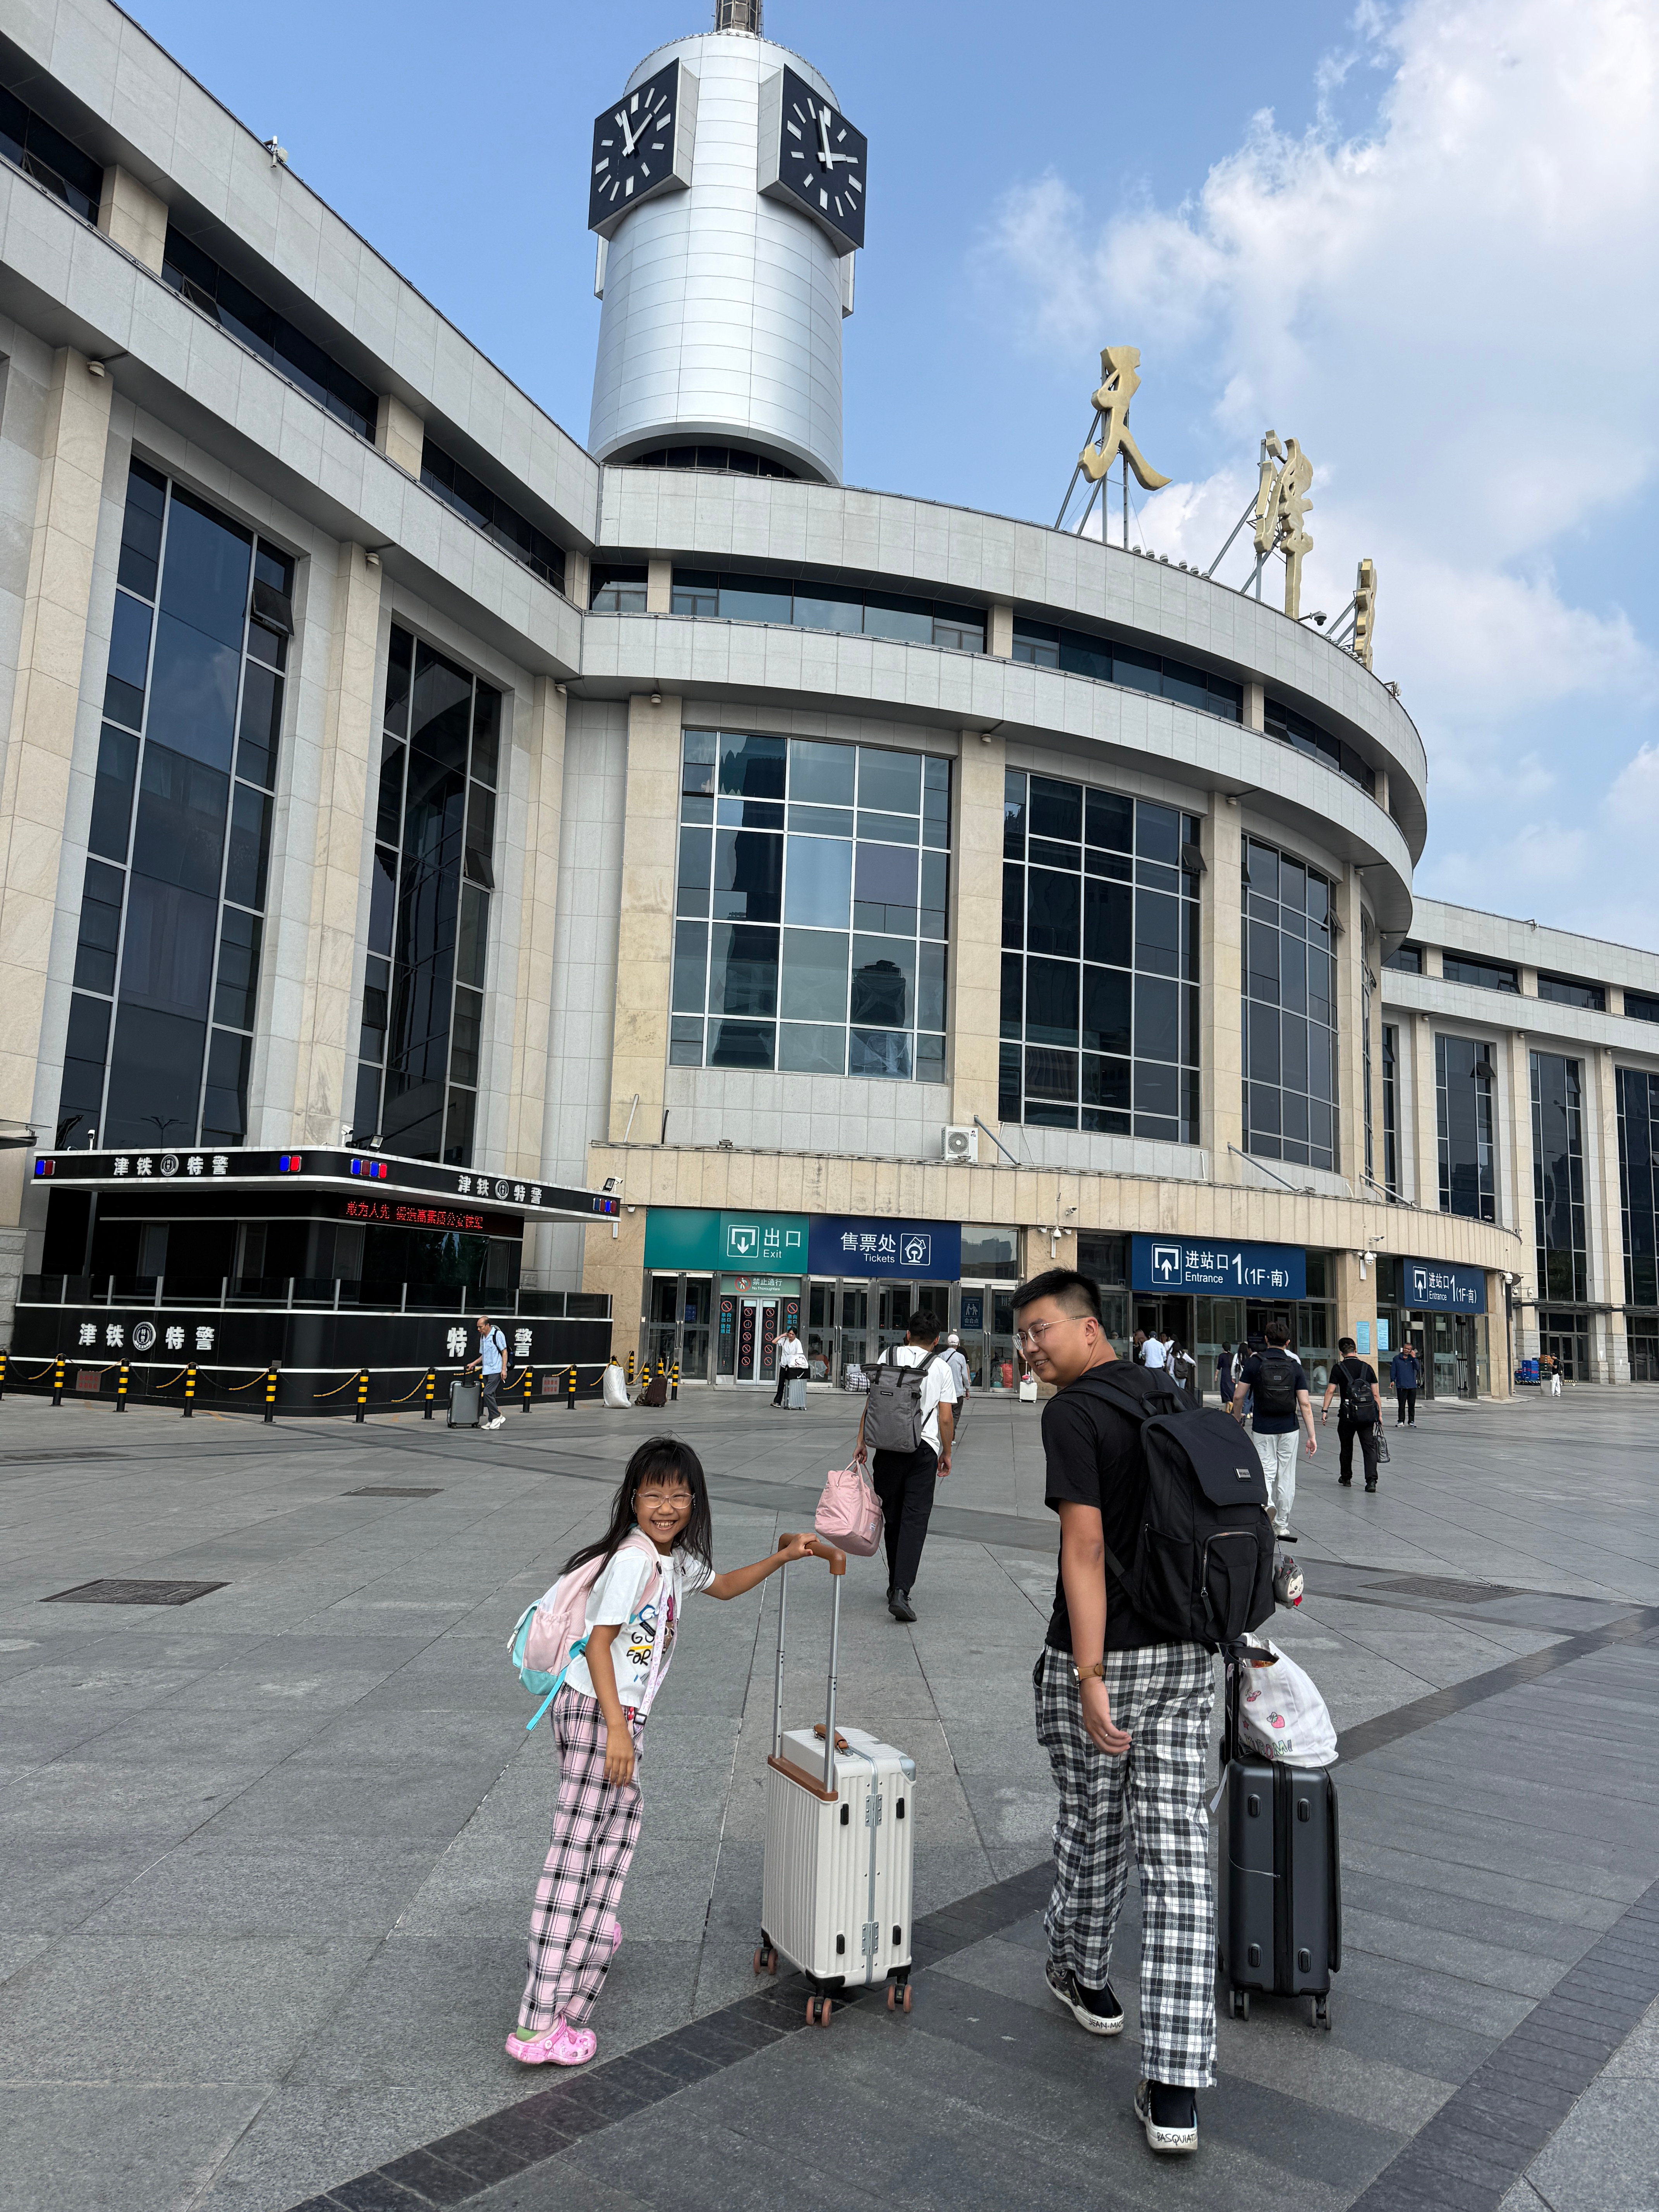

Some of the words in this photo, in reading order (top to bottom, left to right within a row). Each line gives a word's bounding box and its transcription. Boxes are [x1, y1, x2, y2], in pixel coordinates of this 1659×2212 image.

[113, 1157, 152, 1175] 津铁
[187, 1156, 228, 1175] 特警
[458, 1175, 489, 1197] 津铁
[514, 1185, 542, 1204] 特警
[764, 1228, 800, 1247] 出口
[840, 1232, 896, 1253] 售票处
[764, 1249, 781, 1258] Exit
[864, 1254, 895, 1263] Tickets
[1185, 1250, 1228, 1270] 进站口
[752, 1278, 782, 1286] 禁止通行
[1185, 1271, 1223, 1284] Entrance
[1429, 1273, 1449, 1289] 进站口
[1429, 1291, 1447, 1301] Entrance
[78, 1323, 124, 1348] 津铁
[165, 1326, 215, 1350] 特警
[1157, 2131, 1195, 2146] BASQUIAT
